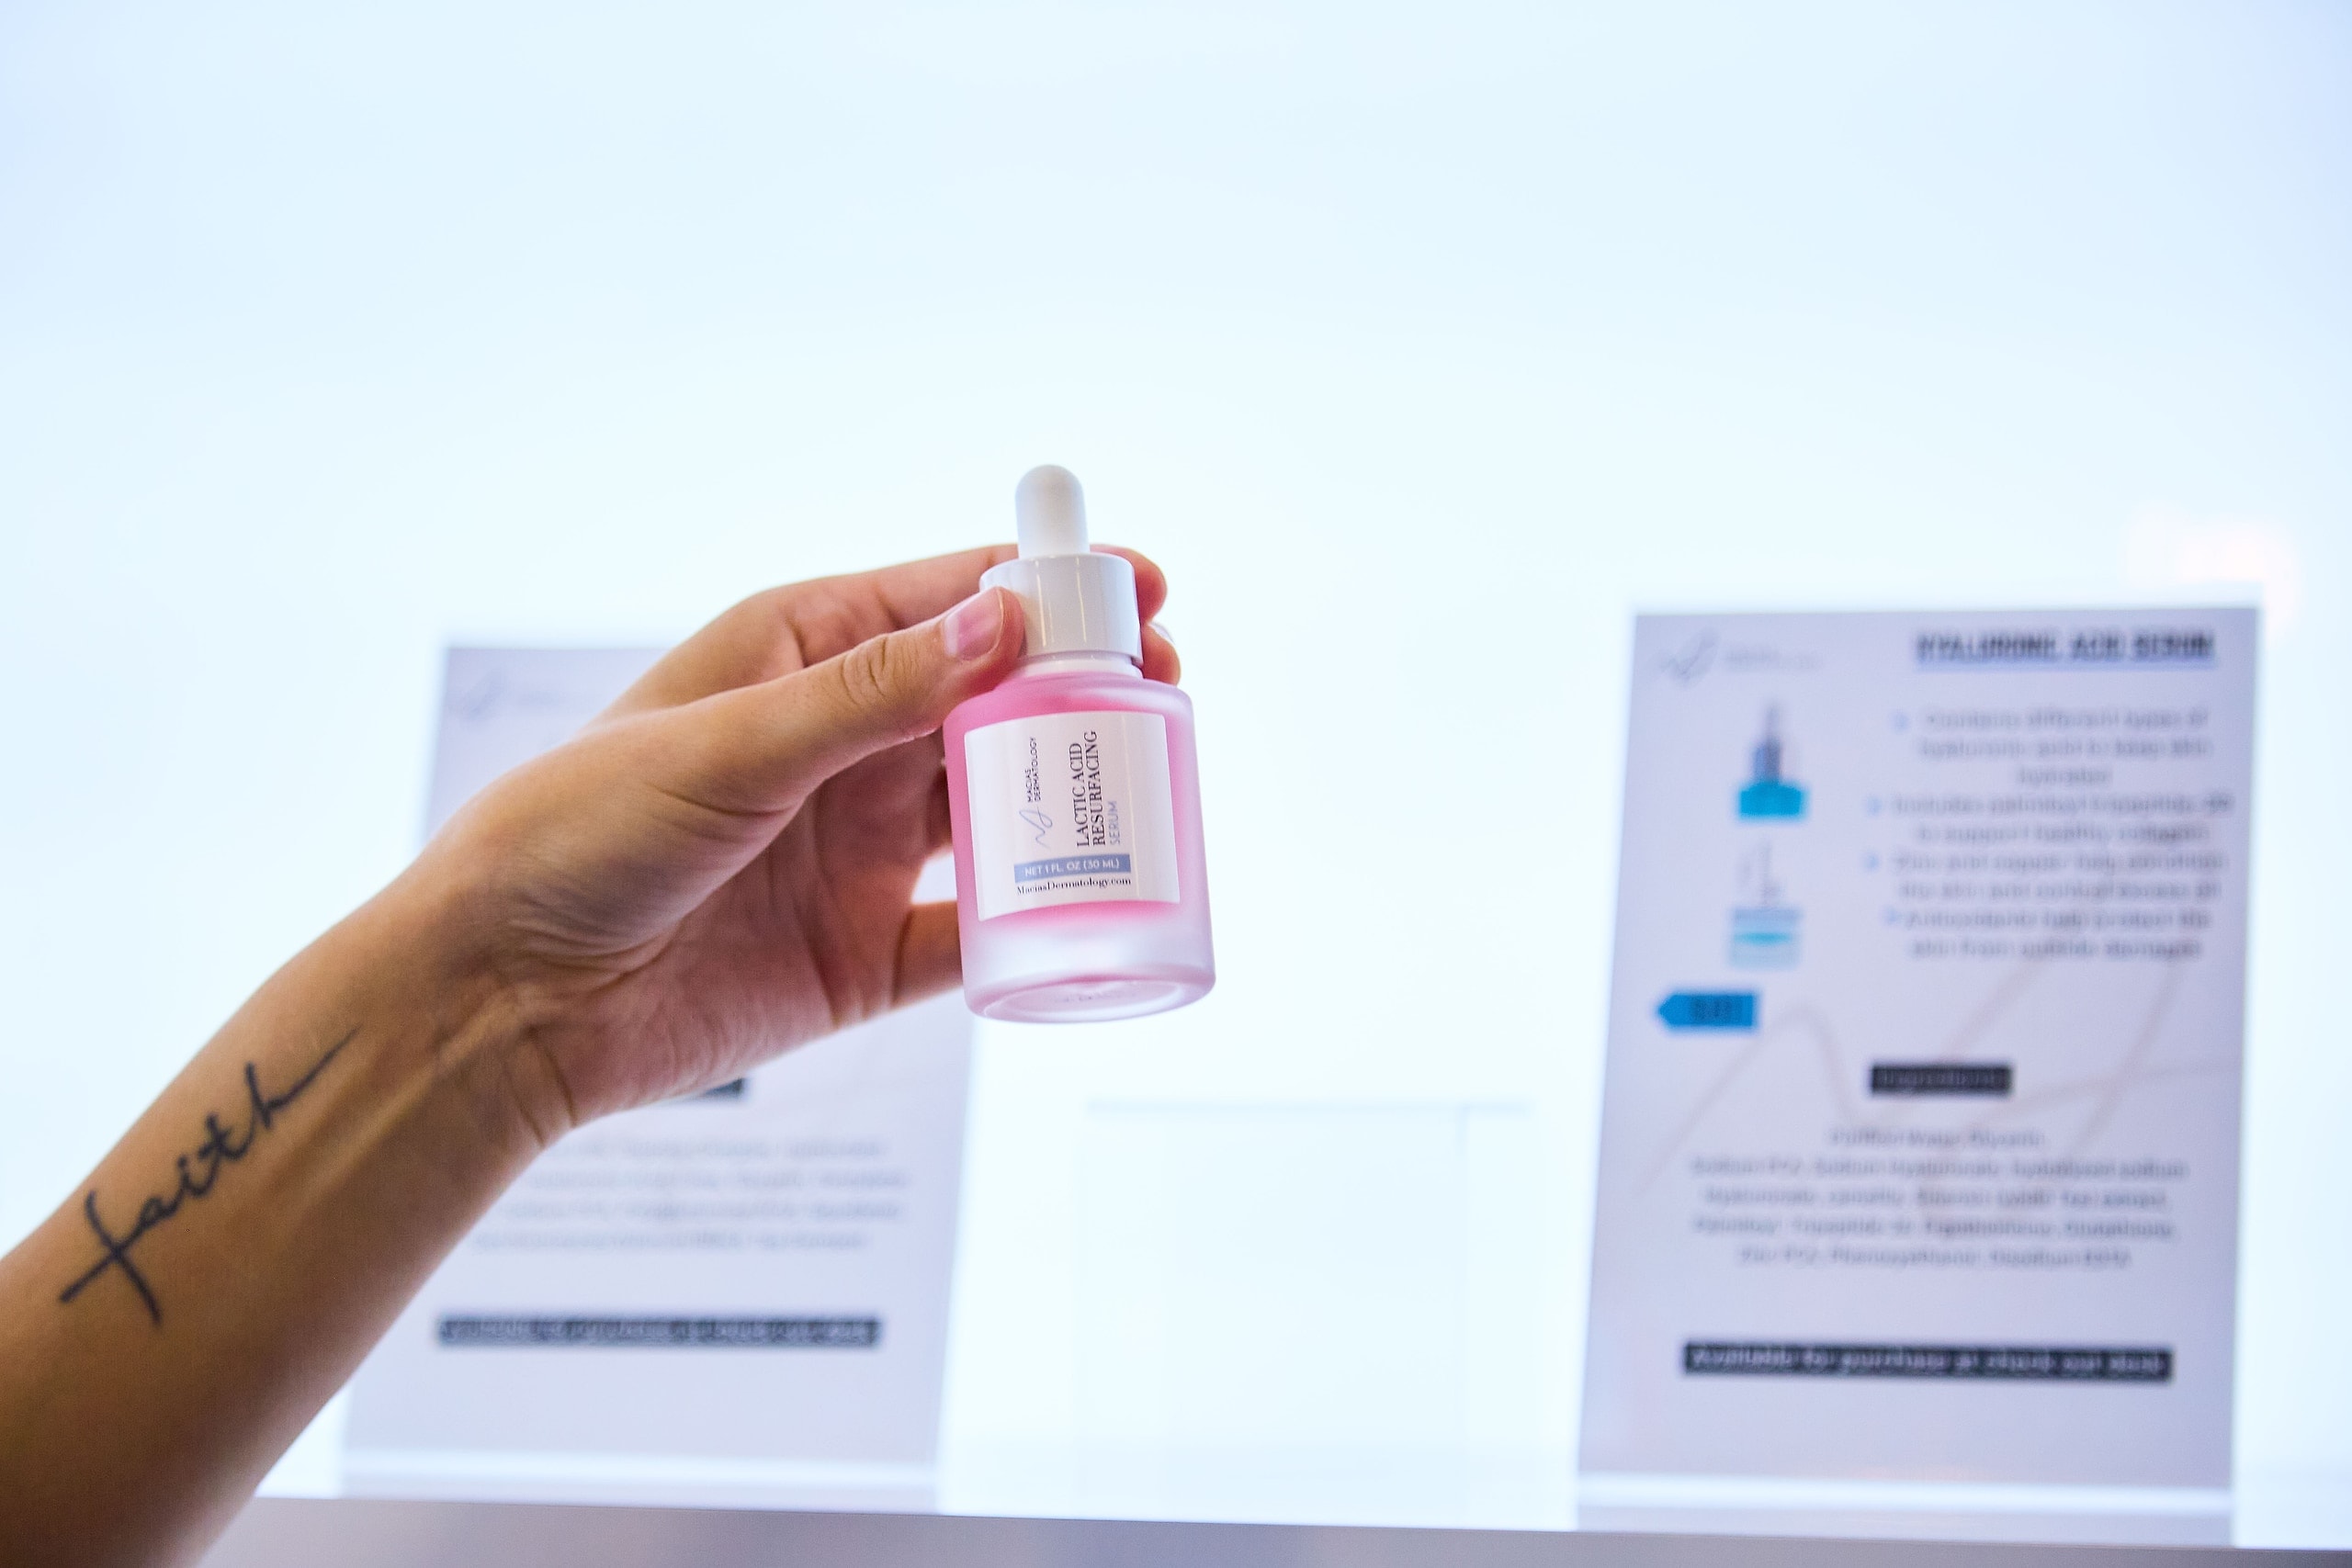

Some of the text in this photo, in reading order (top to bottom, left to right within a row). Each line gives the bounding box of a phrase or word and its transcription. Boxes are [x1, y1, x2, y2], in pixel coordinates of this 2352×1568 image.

[1024, 769, 1034, 803] MACIAS
[1030, 737, 1041, 802] DERMATOLOGY
[1069, 742, 1090, 848] LACTIC ACID
[1084, 730, 1106, 846] RESURFACING
[1107, 801, 1121, 845] SERUM
[1016, 876, 1132, 897] MaciasDermatology.com
[1024, 865, 1043, 877] NET
[1067, 861, 1081, 872] OZ
[1083, 859, 1101, 871] (30
[1102, 857, 1120, 870] ML)
[58, 1022, 364, 1327] faith
